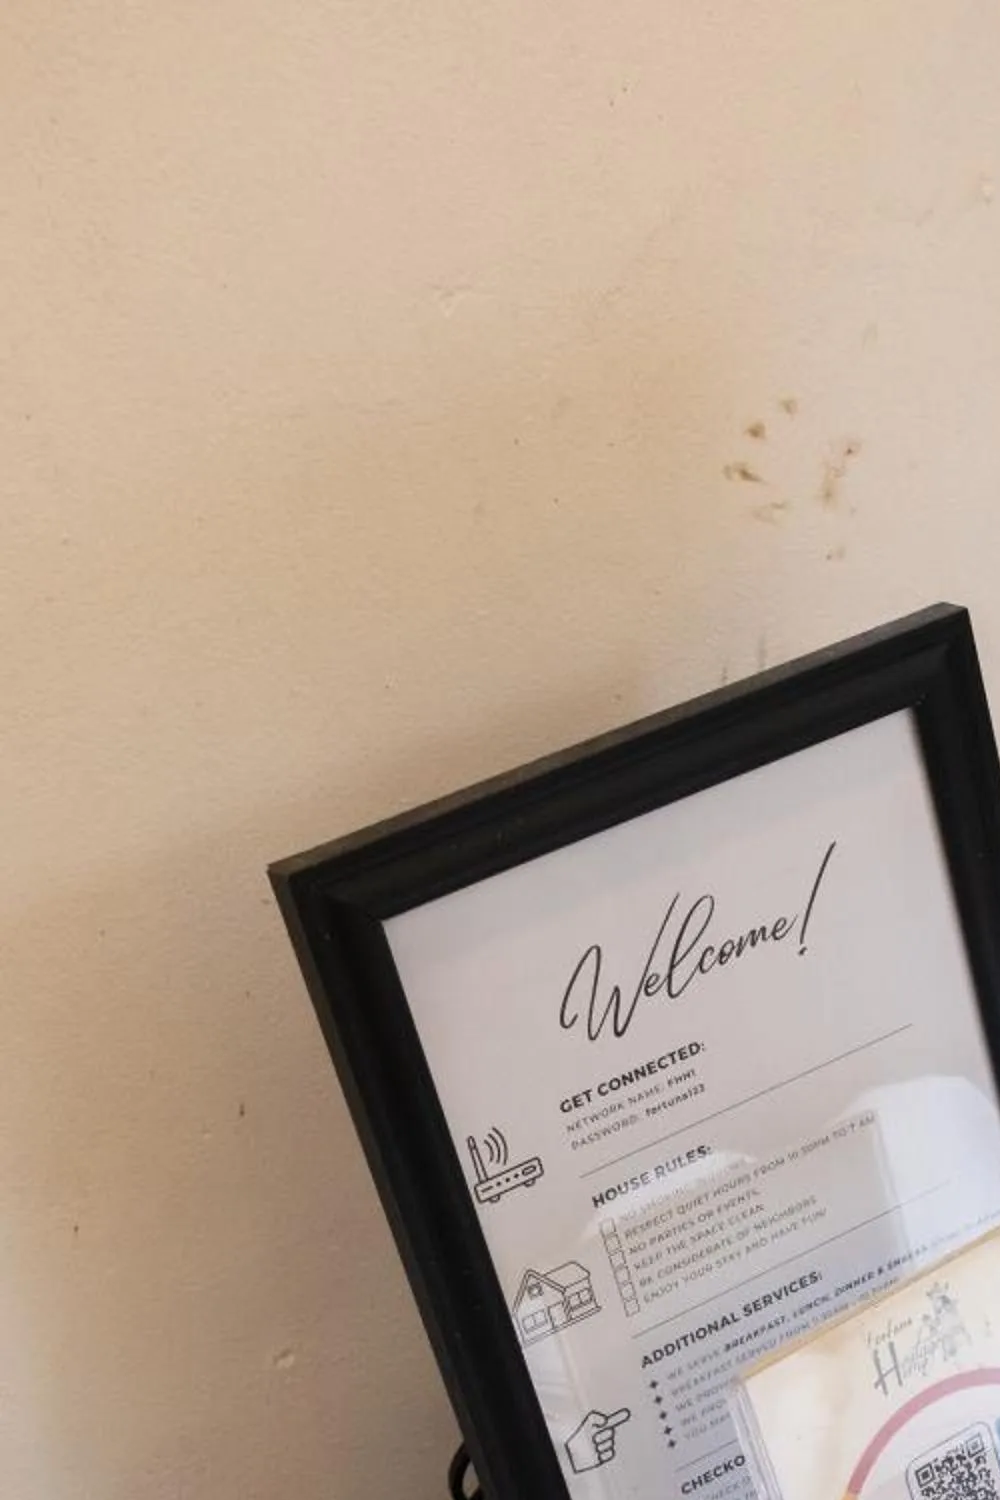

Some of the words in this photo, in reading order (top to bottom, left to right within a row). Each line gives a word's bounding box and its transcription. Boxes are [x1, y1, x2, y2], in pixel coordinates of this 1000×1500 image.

[559, 840, 836, 1041] Welcome!
[558, 1088, 595, 1114] GET
[595, 1038, 706, 1097] CONNECTED:
[644, 1082, 706, 1117] fortuna123
[565, 1100, 624, 1133] NETWORK
[591, 1171, 651, 1208] HOUSE
[652, 1141, 713, 1179] RULES:
[623, 1209, 674, 1240] RESPECT
[674, 1191, 711, 1217] QUIET
[710, 1171, 752, 1198] HOURS
[627, 1240, 648, 1256] NO
[647, 1217, 696, 1247] PARTIES
[696, 1207, 715, 1224] OR
[632, 1249, 664, 1272] KEEP
[665, 1238, 686, 1256] THE
[688, 1220, 725, 1244] SPACE
[642, 1278, 680, 1304] ENJOY
[743, 1234, 769, 1255] AND
[769, 1220, 799, 1242] HAVE
[655, 1235, 733, 1280] CONSIDERATE
[734, 1226, 751, 1242] OF
[832, 1269, 877, 1298] DINNER
[638, 1308, 742, 1368] ADDITIONAL
[740, 1267, 824, 1318] SERVICES:
[678, 1452, 747, 1496] CHECKO
